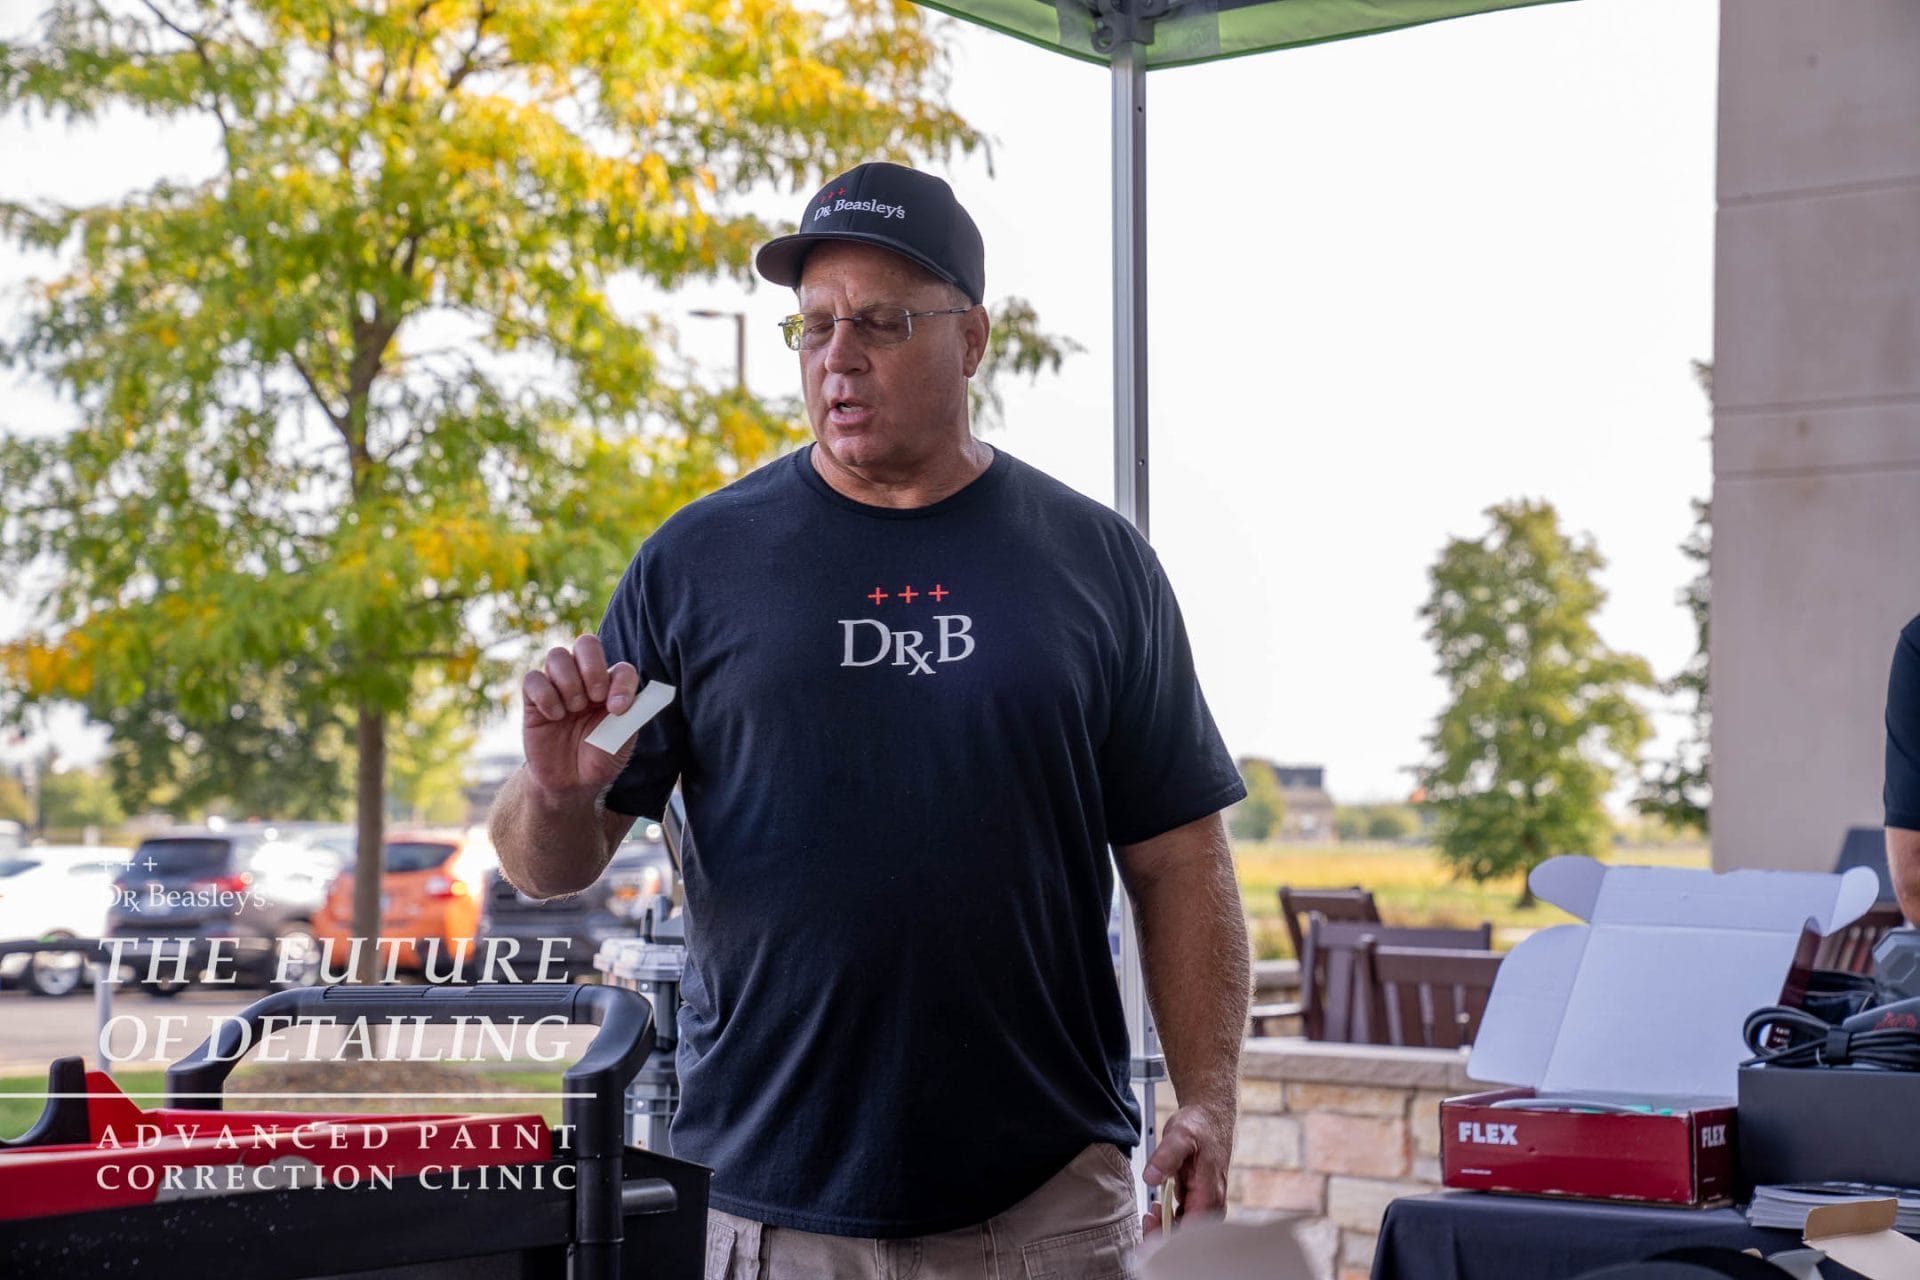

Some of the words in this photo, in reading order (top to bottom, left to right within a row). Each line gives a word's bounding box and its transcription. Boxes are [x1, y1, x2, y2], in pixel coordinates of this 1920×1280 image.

[833, 199, 905, 219] Beasley's
[1458, 1122, 1518, 1145] FLEX
[1701, 1125, 1726, 1147] FLEX
